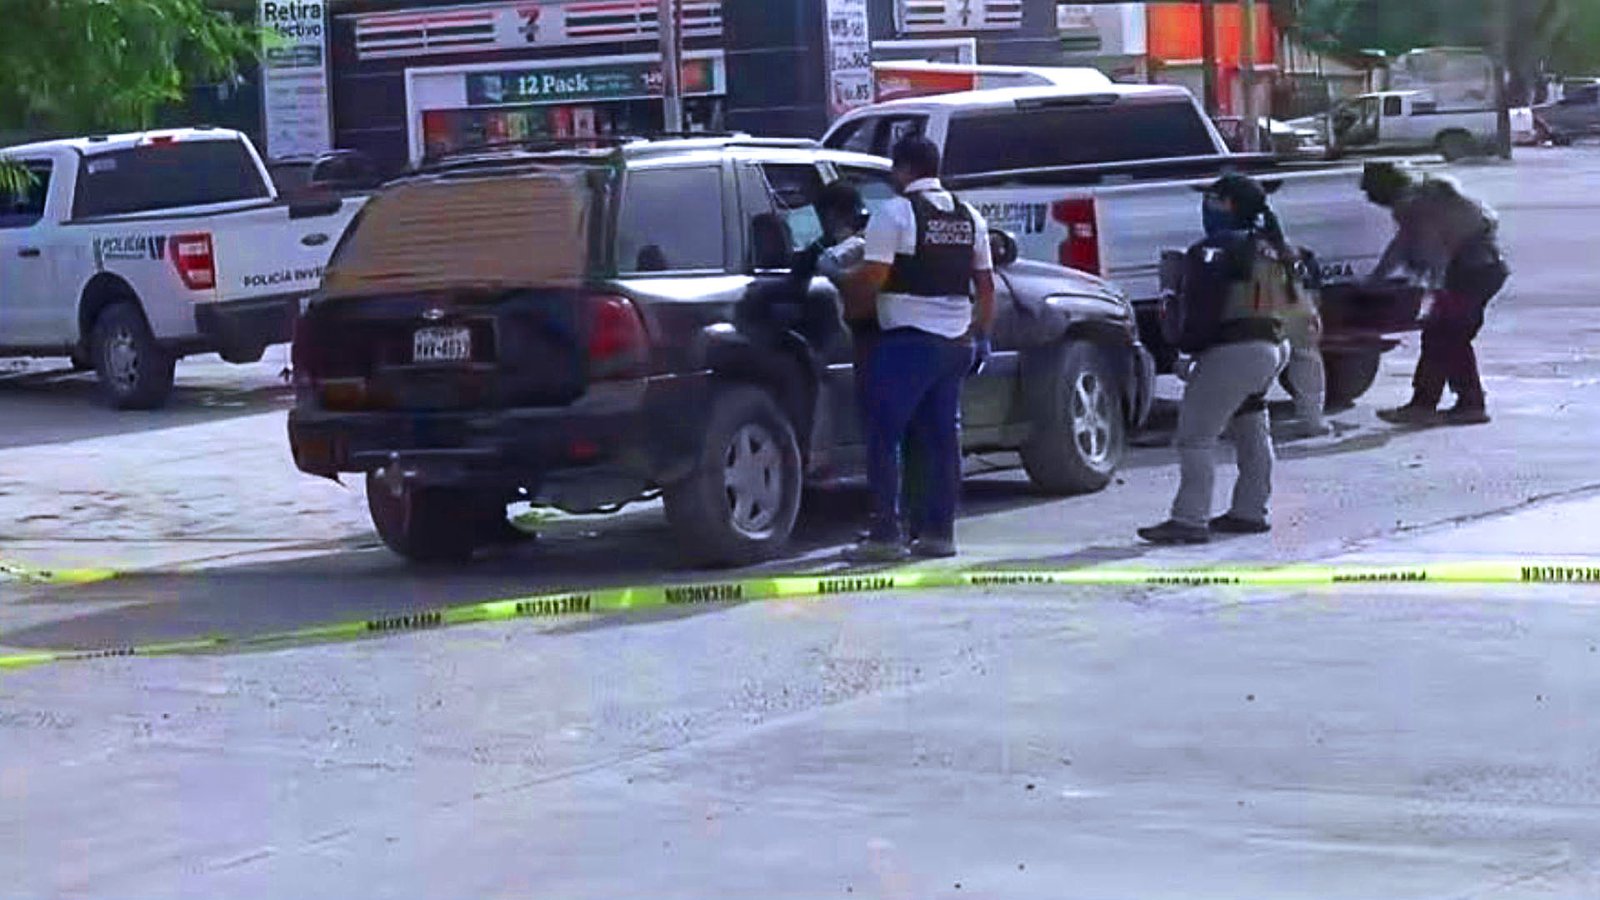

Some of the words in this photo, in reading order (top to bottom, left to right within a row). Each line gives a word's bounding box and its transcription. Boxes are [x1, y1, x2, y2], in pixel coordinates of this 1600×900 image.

[264, 1, 321, 21] Retira
[273, 22, 321, 37] ectivo
[517, 6, 541, 42] 7
[519, 75, 539, 95] 12
[542, 73, 589, 94] Pack
[1319, 263, 1354, 280] ORA
